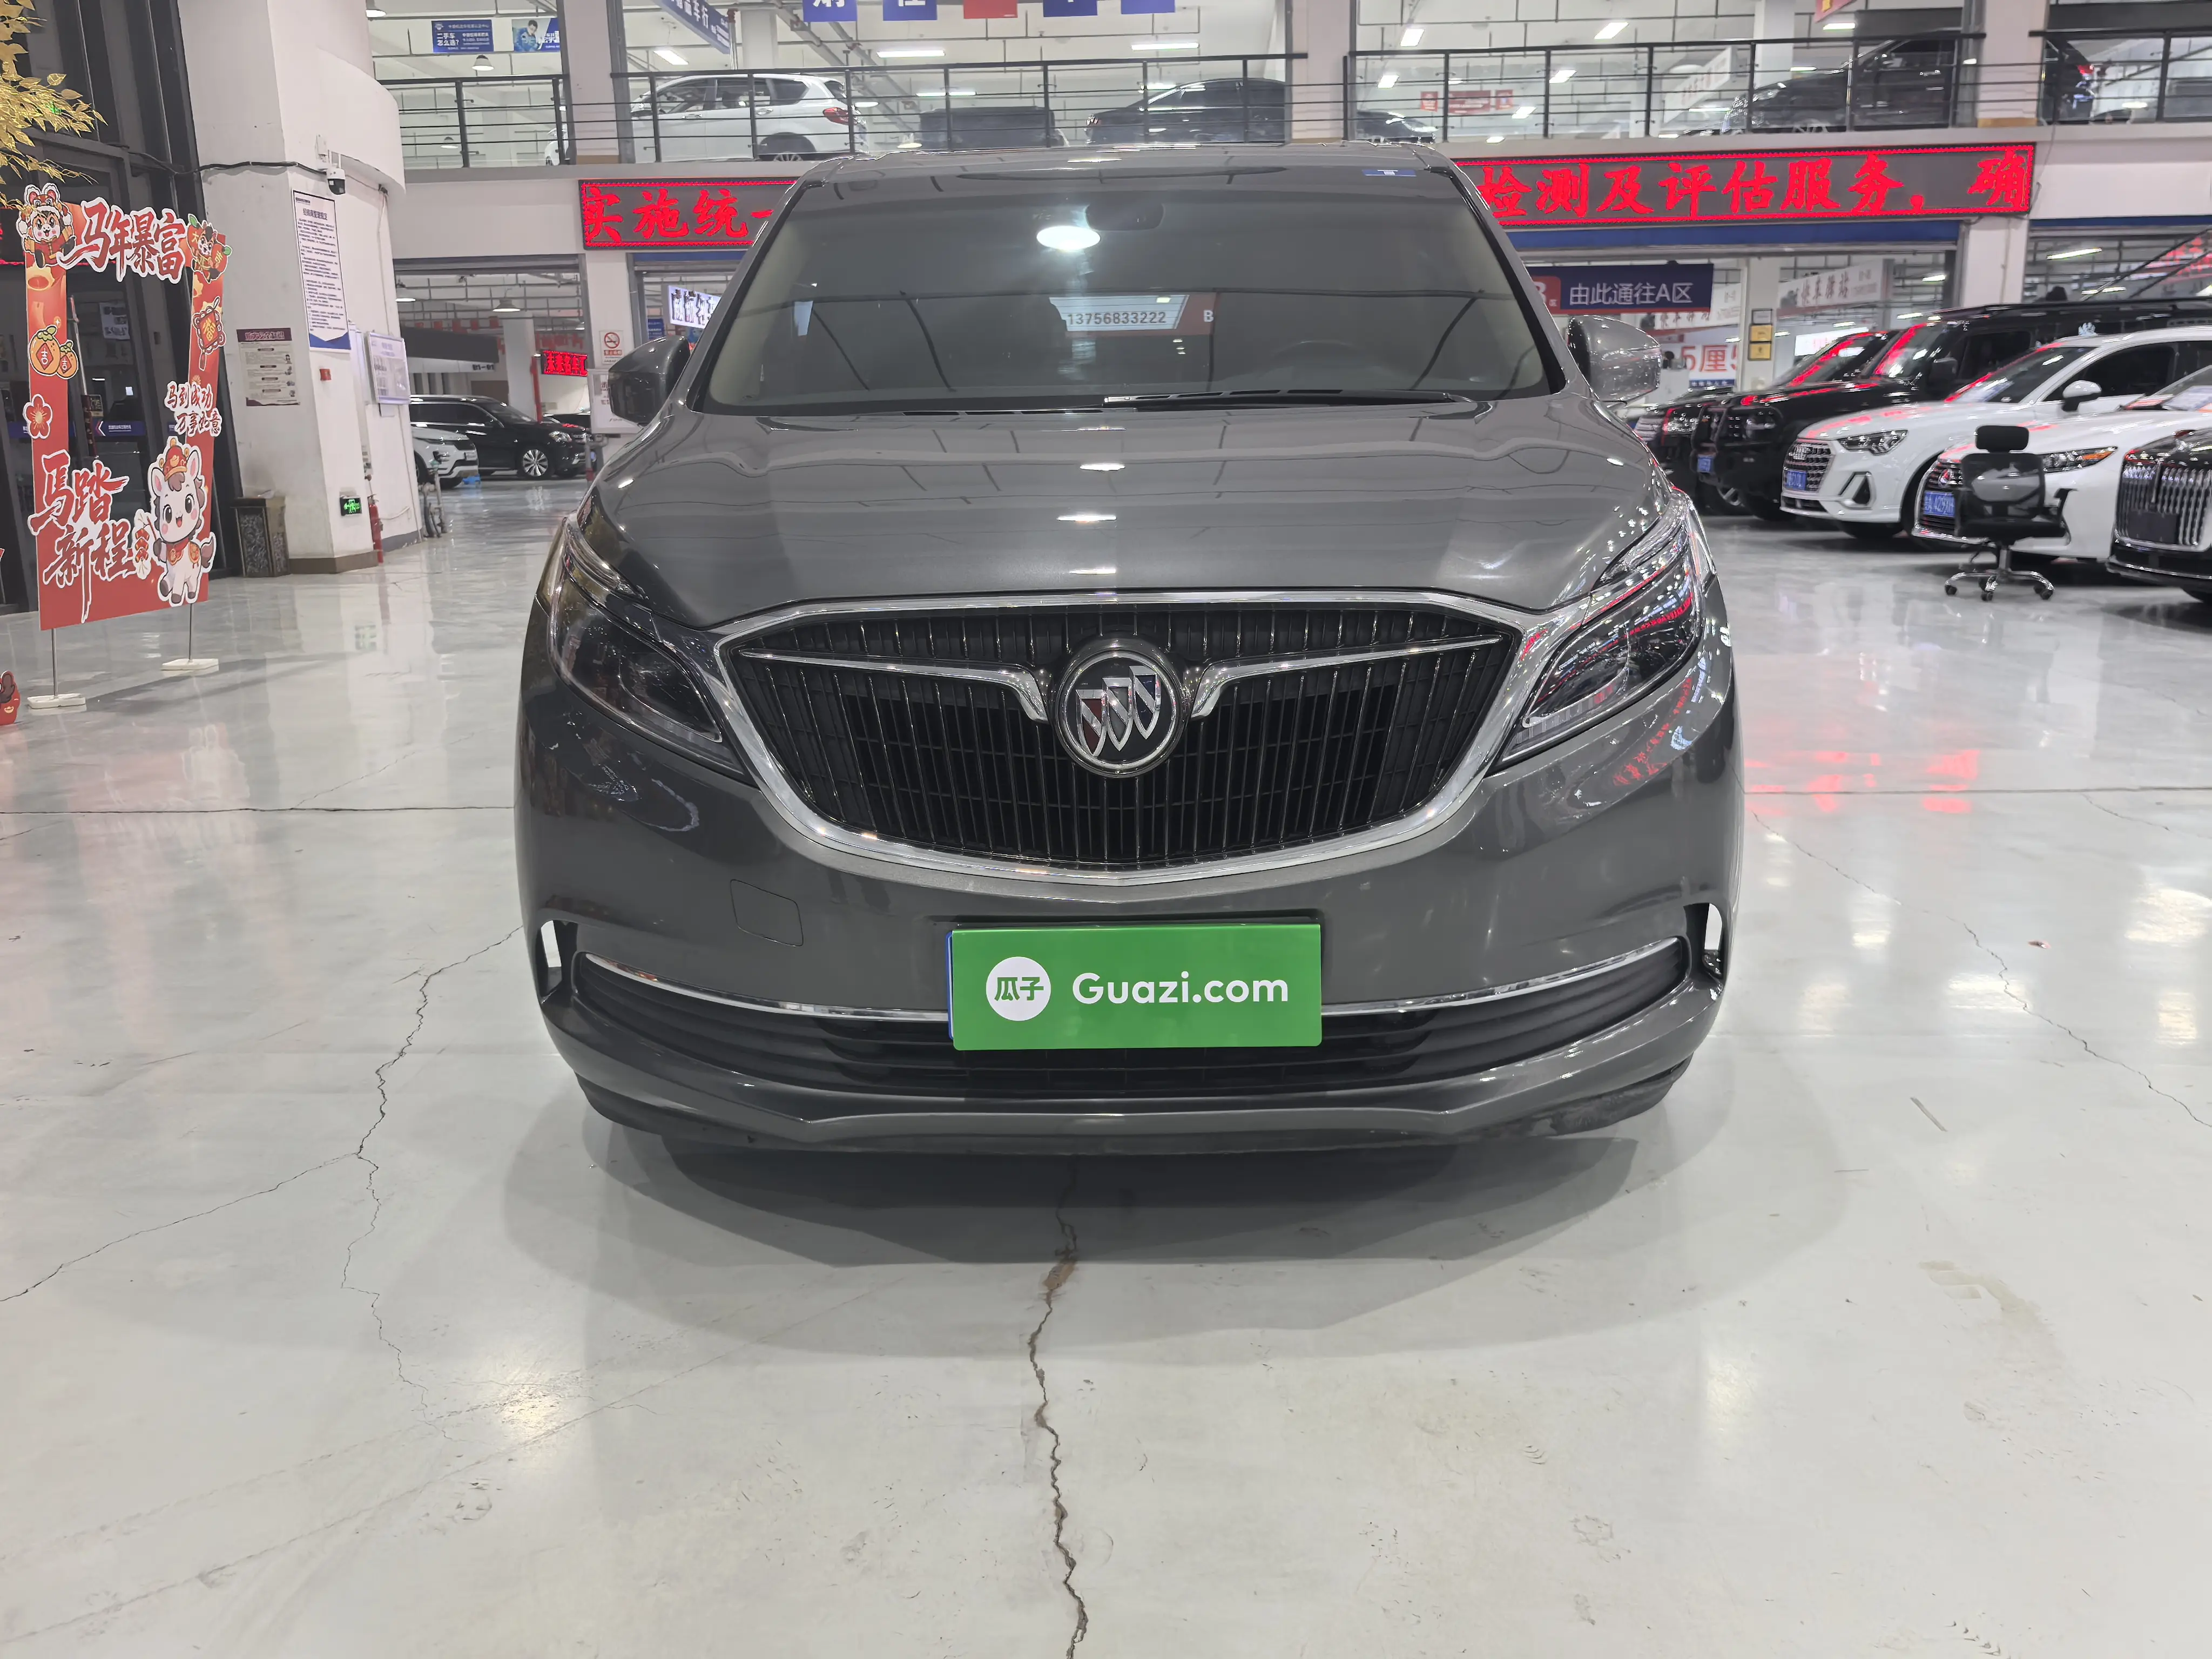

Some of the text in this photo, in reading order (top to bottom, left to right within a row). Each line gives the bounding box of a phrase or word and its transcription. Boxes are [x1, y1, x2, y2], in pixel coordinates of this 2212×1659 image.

[60, 200, 186, 280] 马年暴富
[1569, 282, 1694, 306] 由此通往A区
[1068, 312, 1166, 325] 13756833222
[41, 350, 49, 365] 吉
[61, 359, 69, 371] 吉
[167, 383, 213, 409] 马到成功
[177, 412, 221, 434] 万事如意
[30, 453, 128, 532] 马踏
[45, 522, 135, 620] 新程
[994, 970, 1288, 1004] 瓜子 Guazi.com
